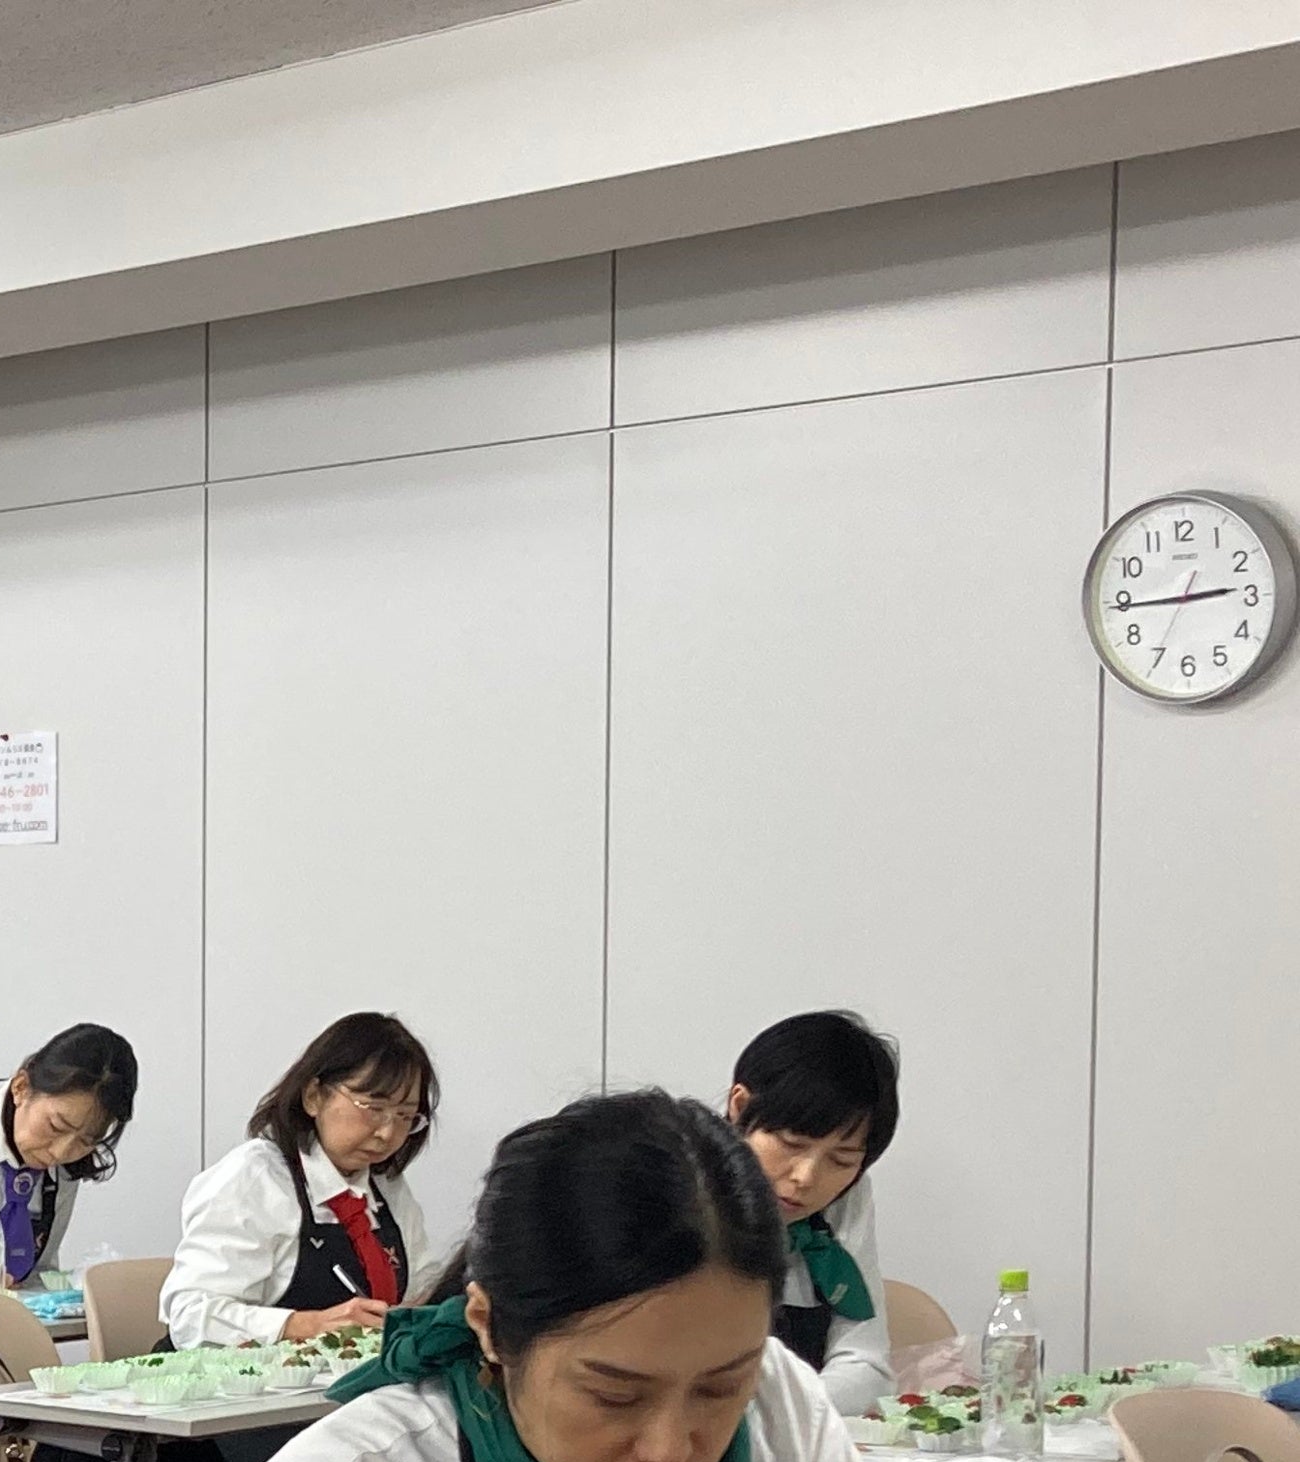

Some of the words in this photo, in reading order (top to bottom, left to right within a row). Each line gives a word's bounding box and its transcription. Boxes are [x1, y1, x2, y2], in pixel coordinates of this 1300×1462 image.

[1145, 530, 1161, 553] 11
[1174, 520, 1194, 542] 12
[1213, 527, 1220, 549] 1
[1121, 556, 1143, 578] 10
[1232, 550, 1249, 573] 2
[1115, 590, 1132, 612] 9
[1243, 584, 1259, 607] 3
[1126, 623, 1141, 645] 8
[1234, 619, 1250, 640] 4
[1150, 647, 1167, 669] 7
[1180, 655, 1196, 678] 6
[1212, 645, 1228, 667] 5
